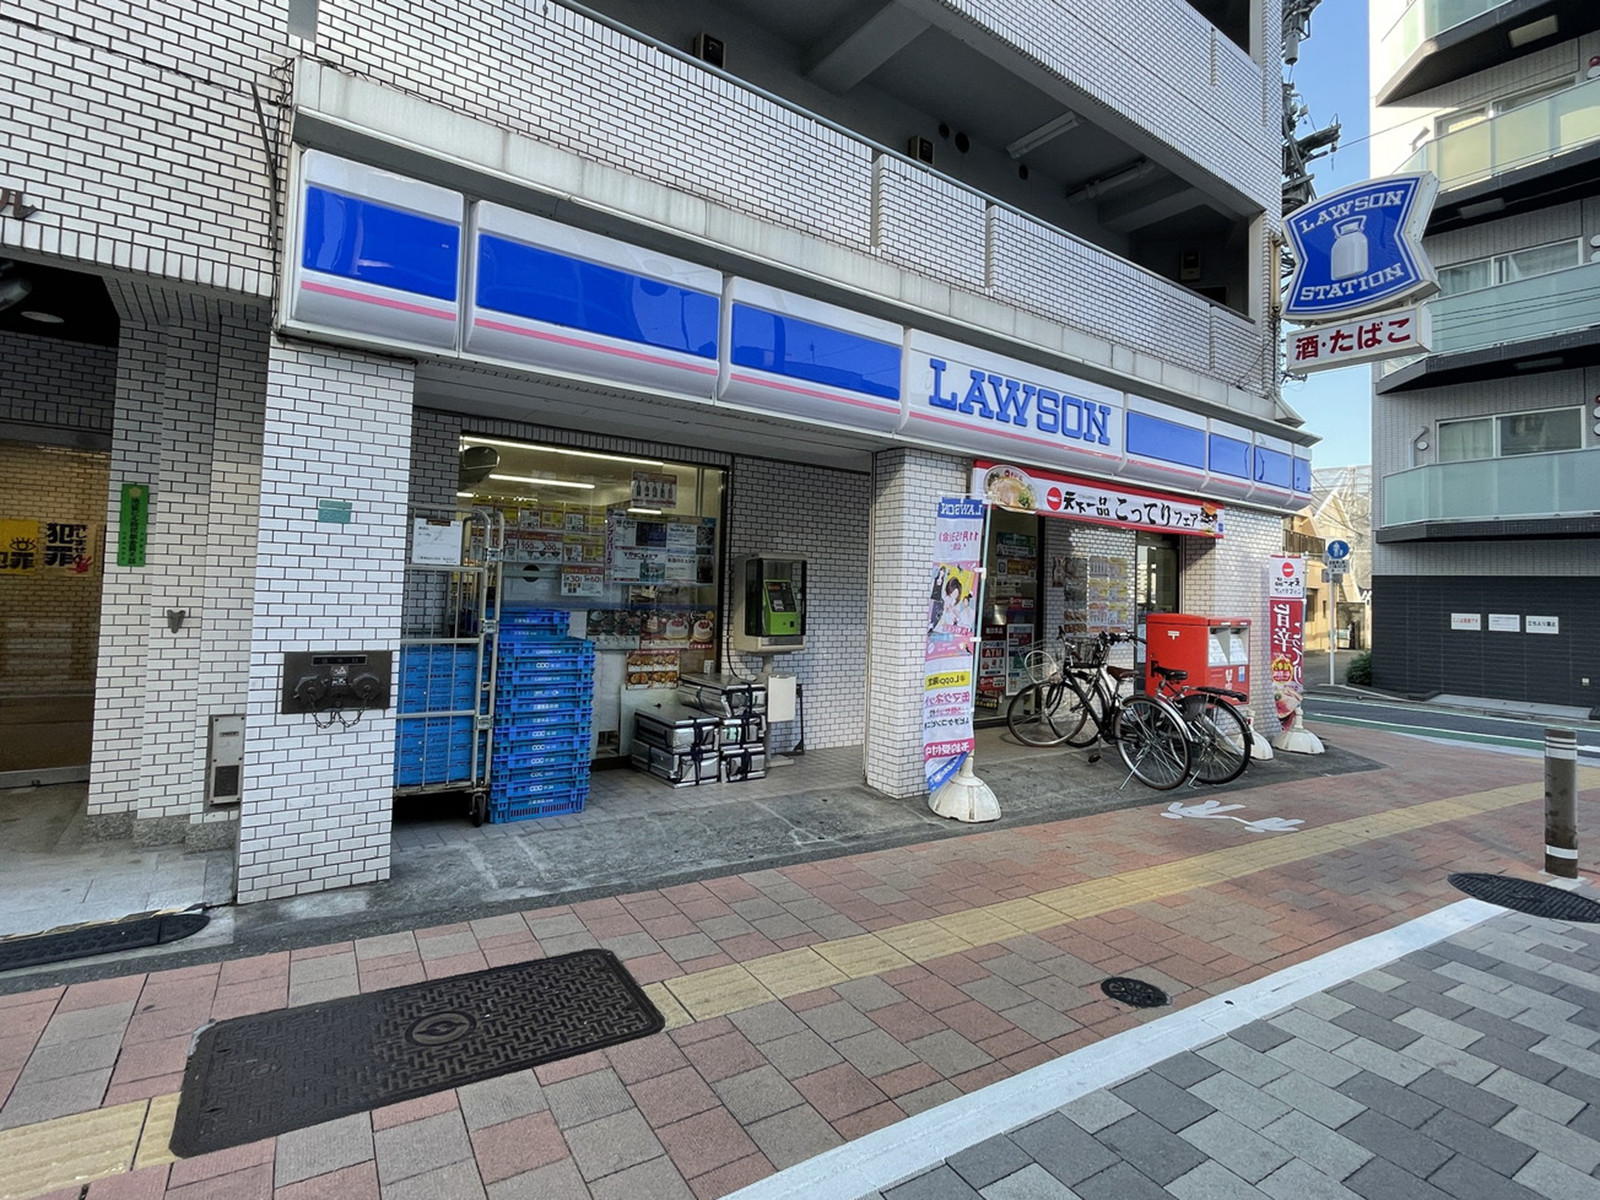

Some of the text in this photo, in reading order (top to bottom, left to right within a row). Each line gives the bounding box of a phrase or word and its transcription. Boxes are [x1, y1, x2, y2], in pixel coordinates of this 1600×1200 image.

[1299, 189, 1405, 234] LAWSON
[1300, 263, 1405, 301] STATION
[1295, 317, 1411, 361] 酒・たばこ
[929, 358, 1112, 446] LAWSON
[1063, 491, 1110, 517] 天下一品
[45, 523, 74, 567] 犯罪
[984, 648, 1003, 657] ATM
